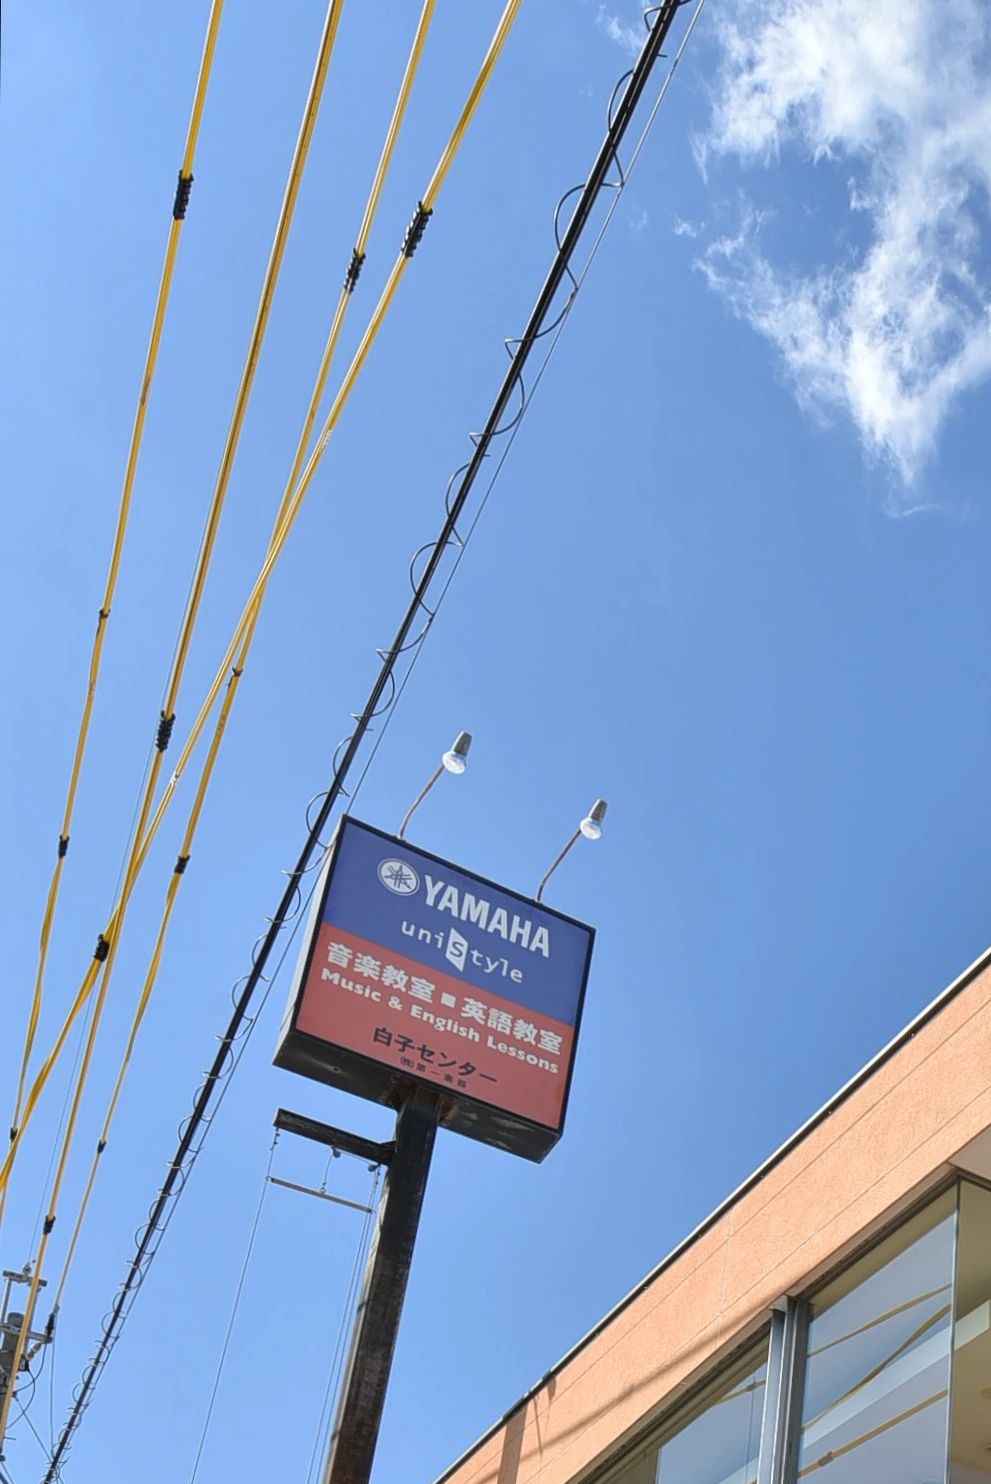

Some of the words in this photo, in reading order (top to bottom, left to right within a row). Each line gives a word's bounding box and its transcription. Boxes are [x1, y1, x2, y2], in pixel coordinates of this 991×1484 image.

[424, 874, 550, 958] YAMAHA
[321, 967, 382, 1003] Music
[388, 995, 404, 1012] &
[410, 1004, 480, 1042] English
[487, 1032, 559, 1075] Lessons
[372, 1026, 498, 1083] 白子センター
